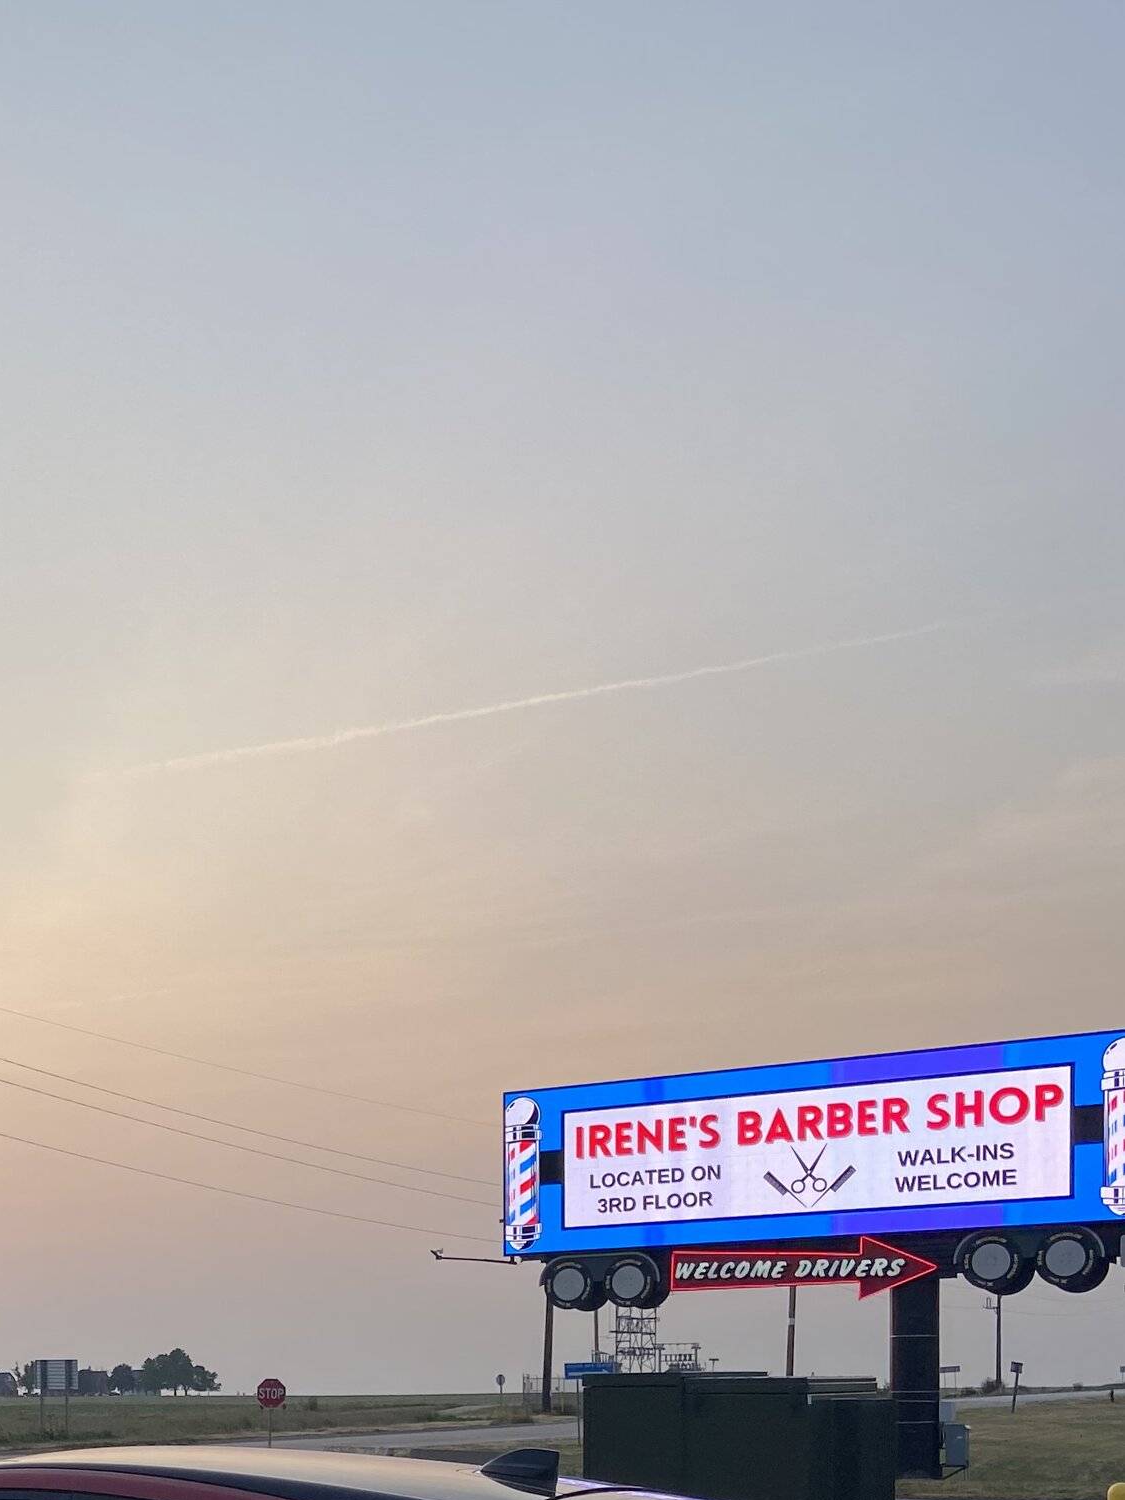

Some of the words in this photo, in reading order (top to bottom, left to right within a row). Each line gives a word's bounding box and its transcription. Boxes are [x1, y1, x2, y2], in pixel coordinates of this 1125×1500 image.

[576, 1114, 721, 1159] IRENE'S
[738, 1097, 910, 1145] BARBER
[926, 1083, 1064, 1130] SHOP
[898, 1142, 1015, 1168] WALK-INS
[589, 1168, 685, 1189] LOCATED
[691, 1164, 722, 1181] ON
[895, 1169, 1017, 1193] WELCOME
[597, 1197, 636, 1214] 3RD
[643, 1191, 713, 1211] FLOOR
[675, 1260, 788, 1280] WELCOME
[794, 1258, 906, 1278] DRIVERS
[259, 1387, 284, 1399] STOP
